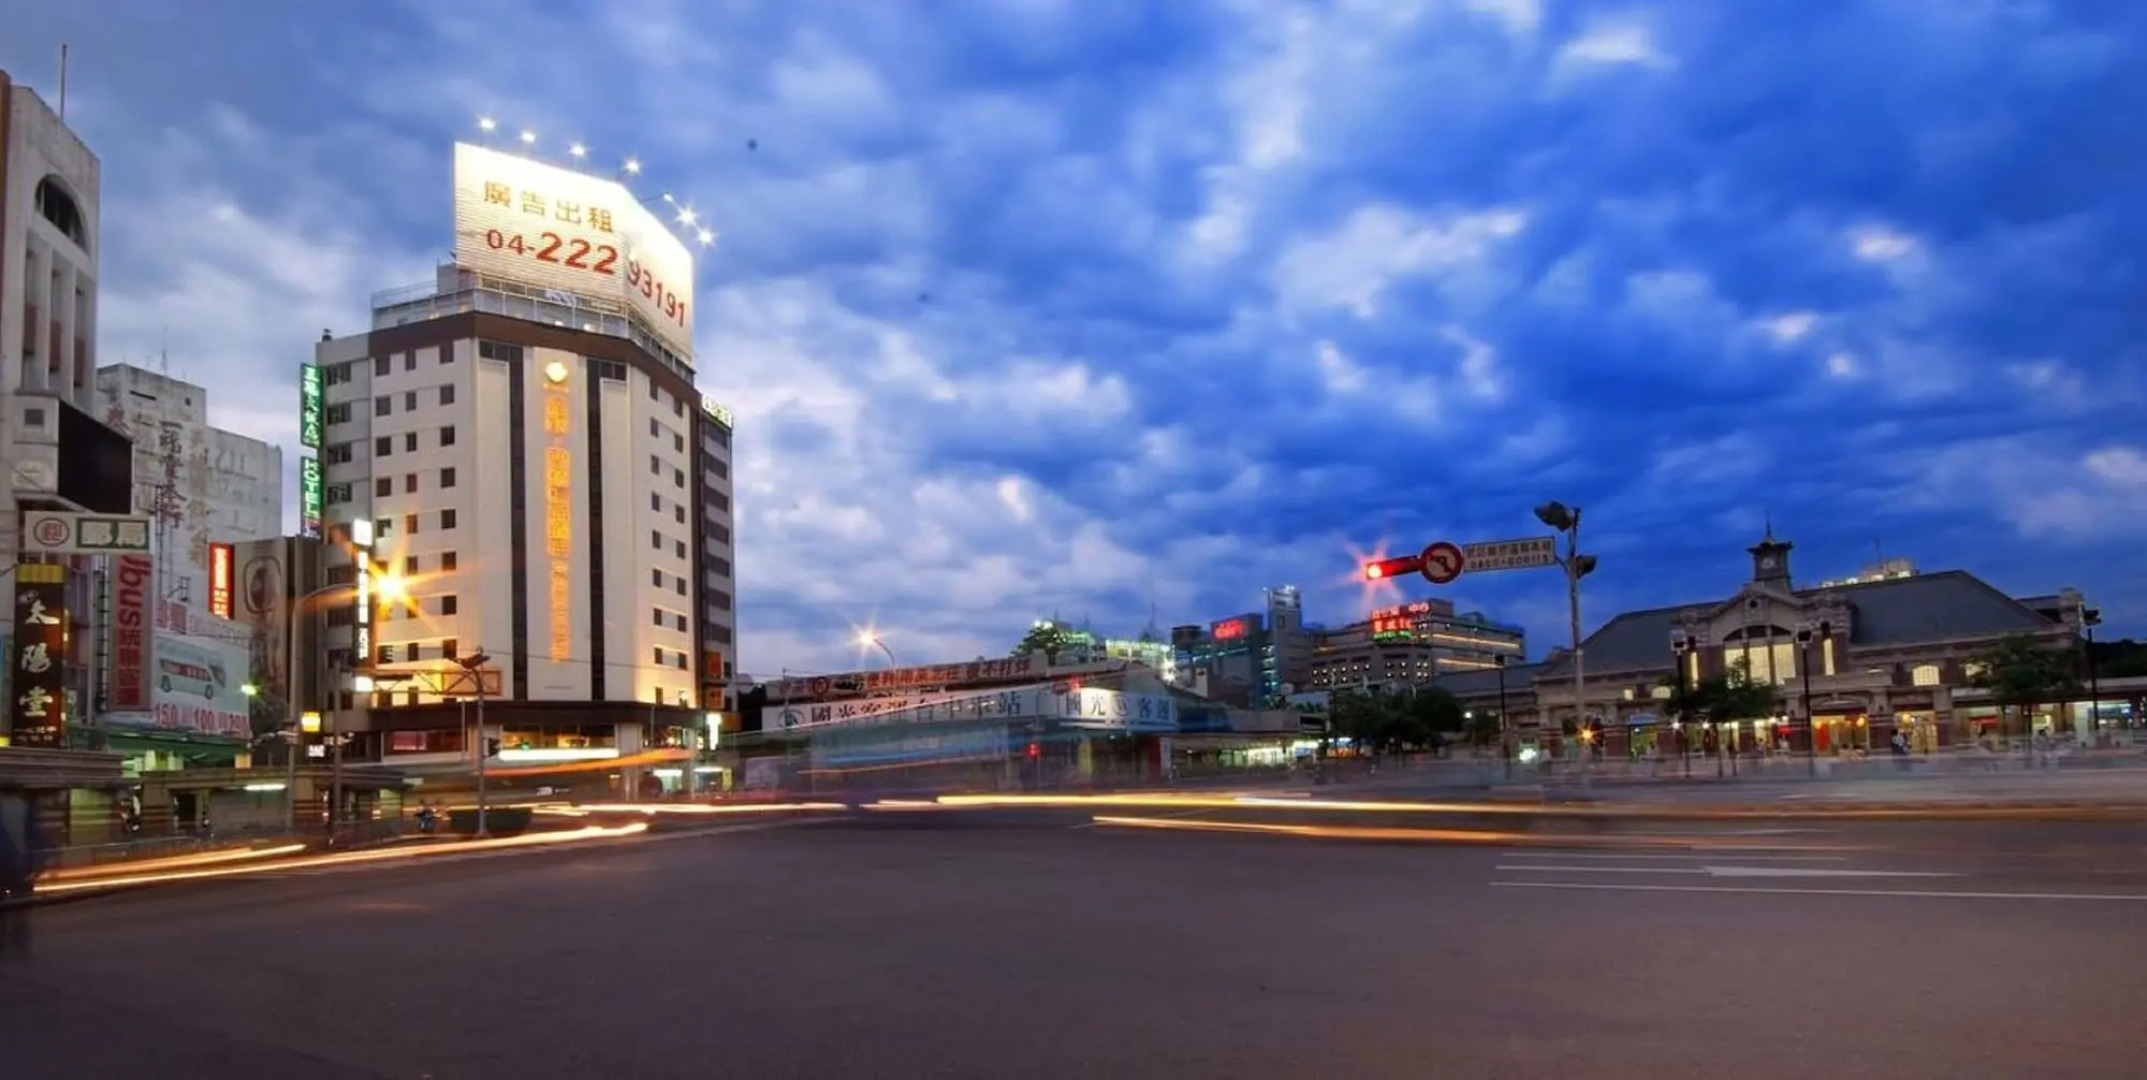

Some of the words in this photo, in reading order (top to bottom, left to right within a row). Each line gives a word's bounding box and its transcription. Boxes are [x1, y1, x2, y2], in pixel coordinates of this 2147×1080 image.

[485, 182, 613, 233] 廣告出租
[487, 229, 618, 275] 04-222
[627, 260, 686, 327] 93191
[304, 459, 320, 516] HOTEL
[19, 600, 60, 717] 太陽堂
